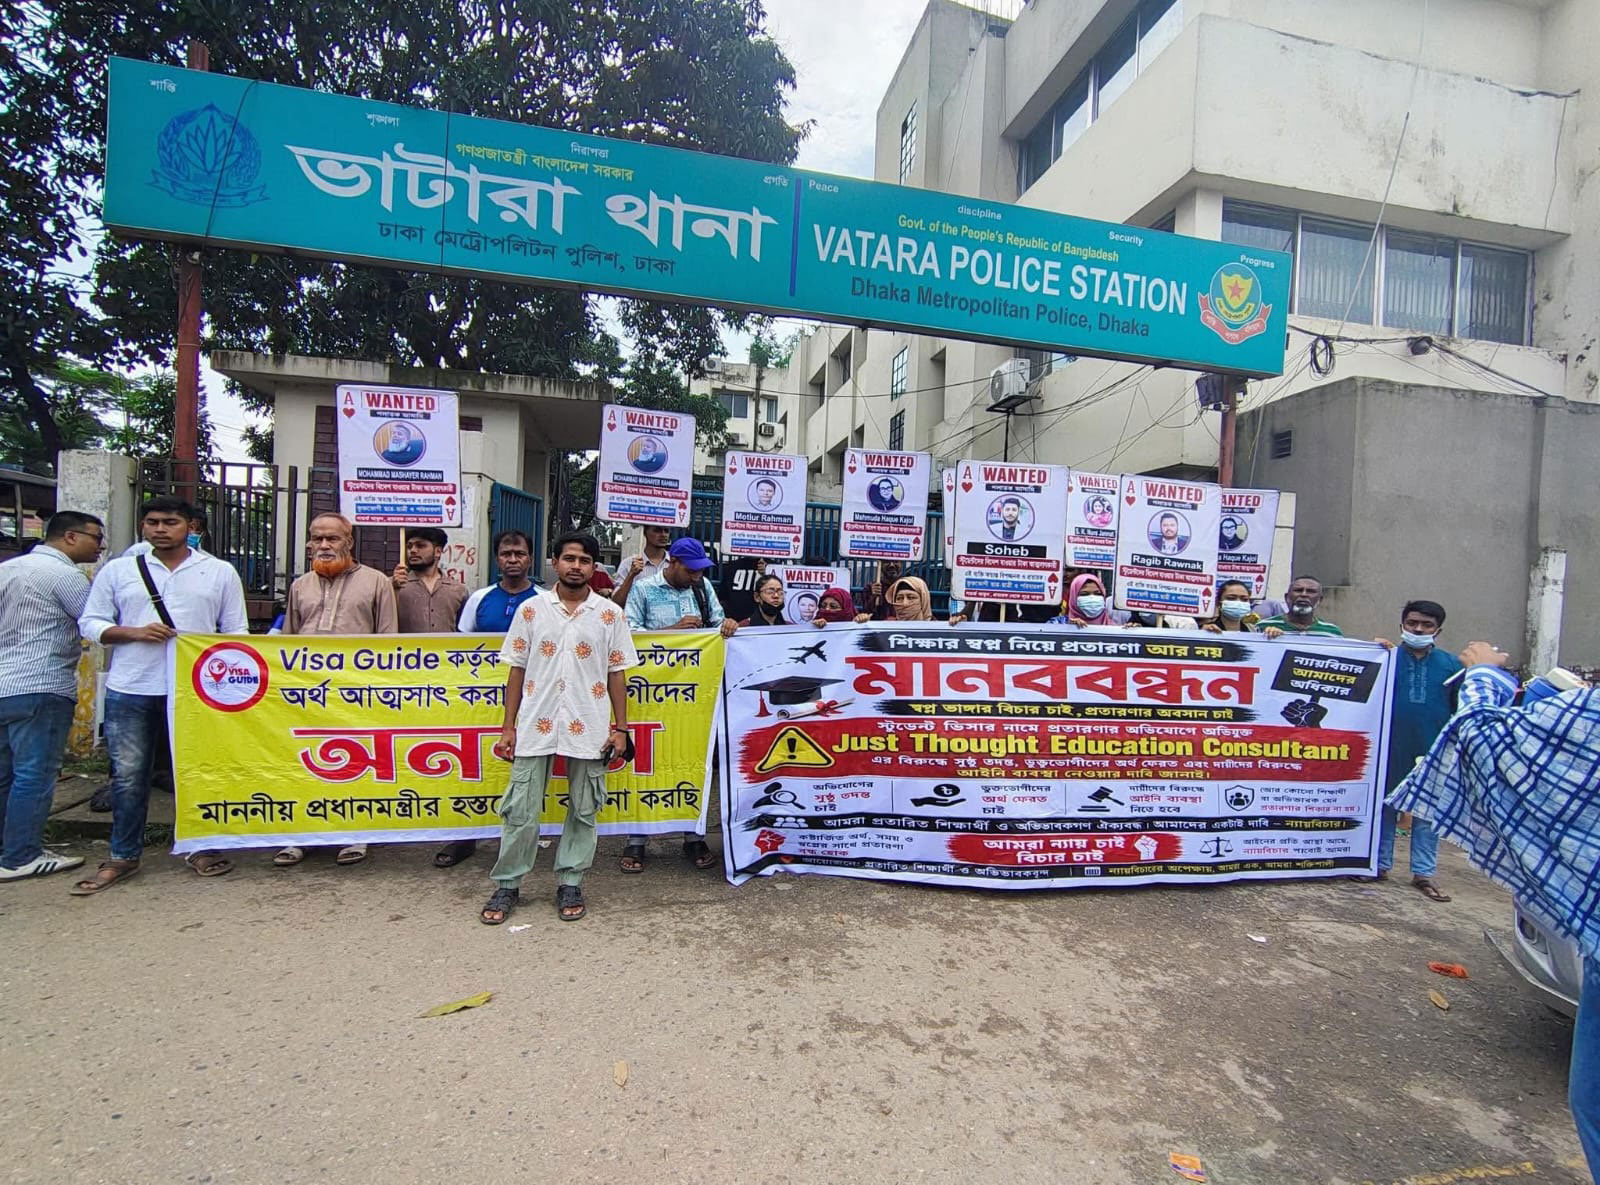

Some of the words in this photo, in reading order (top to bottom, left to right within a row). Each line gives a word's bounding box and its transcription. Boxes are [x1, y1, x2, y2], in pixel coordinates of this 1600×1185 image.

[149, 77, 177, 94] শান্তি
[455, 140, 527, 168] গণপ্রজাতন্ত্রী
[533, 149, 588, 176] বাংলাদেশ
[591, 160, 634, 183] সরকার
[762, 173, 789, 188] প্রগতি
[808, 179, 840, 194] Peace
[284, 141, 583, 236] ভাটারা
[605, 189, 779, 263] থানা
[957, 204, 1003, 221] discipline
[898, 214, 927, 233] Govt.
[928, 221, 941, 234] of
[942, 222, 960, 236] the
[961, 225, 1004, 247] People's
[1005, 231, 1050, 252] Republic
[1051, 239, 1064, 253] of
[1063, 240, 1120, 264] Bangladesh
[1109, 231, 1144, 247] Security
[377, 221, 424, 246] ঢাকা
[433, 223, 557, 263] মেট্রোপলিটন
[564, 244, 626, 274] পুলিশ,
[634, 252, 677, 277] ঢাকা
[1240, 253, 1276, 269] Progress
[813, 223, 942, 280] VATARA
[950, 250, 1061, 298] POLICE
[1070, 265, 1188, 316] STATION
[850, 277, 913, 304] Dhaka
[916, 286, 1031, 326] Metropolitan
[1035, 301, 1093, 332] Police,
[1097, 312, 1149, 338] Dhaka
[366, 393, 435, 411] WANTED
[625, 412, 678, 429] WANTED
[745, 457, 792, 470] WANTED
[865, 454, 914, 468] WANTED
[420, 472, 442, 480] RAHMAN
[983, 467, 1047, 484] WANTED
[1079, 476, 1118, 489] WANTED
[1145, 482, 1203, 501] WANTED
[735, 512, 760, 521] Motiur
[761, 514, 793, 524] Rahman
[984, 544, 1029, 556] Soheb
[1133, 554, 1161, 566] Ragib
[1164, 558, 1202, 570] Rawnak
[786, 569, 834, 583] WANTED
[887, 634, 960, 650] শিক্ষার
[965, 637, 1002, 651] স্বপ্ন
[1008, 637, 1056, 652] নিয়ে
[1062, 641, 1141, 655] প্রতারণা
[1145, 643, 1190, 657] আর
[1194, 645, 1224, 659] নয়
[280, 646, 345, 671] Visa
[353, 647, 440, 671] Guide
[1293, 655, 1365, 675] ন্যায়বিচার
[228, 668, 250, 676] VISA
[228, 676, 259, 684] GUIDE
[1292, 666, 1357, 685] আমাদের
[845, 656, 1259, 705] মানববন্ধন
[1290, 678, 1352, 696] অধিকার
[280, 679, 332, 709] অর্থ
[338, 684, 449, 711] আত্মসাৎ
[908, 703, 938, 715] স্বপ্ন
[996, 702, 1041, 715] বিচার
[1085, 706, 1153, 718] প্রতারণার
[1156, 708, 1209, 720] অবসান
[1212, 708, 1234, 720] চাই
[876, 720, 936, 733] স্টুডেন্ট
[943, 720, 996, 732] ভিসার
[1002, 721, 1039, 733] নামে
[1047, 724, 1121, 735] প্রতারণার
[1125, 725, 1196, 737] অভিযোগে
[1202, 725, 1255, 738] অভিযুক্ত
[832, 733, 899, 754] Just
[909, 732, 1039, 758] Thought
[1050, 734, 1192, 757] Education
[1203, 739, 1350, 761] Consultant
[871, 756, 892, 765] এর
[898, 755, 949, 767] বিরুদ্ধে
[954, 757, 977, 768] সুষ্ঠু
[983, 757, 1018, 767] তদন্ত,
[1114, 756, 1137, 768] অর্থ
[1141, 759, 1178, 768] ফেরত
[1183, 759, 1209, 769] এবং
[1212, 759, 1253, 770] দায়ীদের
[1257, 760, 1303, 771] বিরুদ্ধে
[956, 767, 1006, 778] আইনি
[1011, 768, 1058, 779] ব্যবস্থা
[1064, 769, 1121, 779] নেওয়ার
[1126, 769, 1153, 779] দাবি
[1158, 769, 1210, 779] জানাই।
[812, 780, 874, 791] অভিযোগের
[1128, 783, 1165, 792] দায়ীদের
[1170, 783, 1205, 793] বিরুদ্ধে
[197, 793, 296, 824] মাননীয়
[305, 788, 440, 820] প্রধানমন্ত্রীর
[638, 781, 701, 812] করছি
[814, 792, 835, 803] সুষ্ঠু
[840, 791, 871, 800] তদন্ত
[981, 794, 1008, 803] অর্থ
[1012, 795, 1048, 804] ফেরত
[1129, 793, 1161, 803] আইনি
[1166, 795, 1202, 804] ব্যবস্থা
[813, 803, 837, 813] চাই
[981, 805, 1005, 814] চাই
[1130, 804, 1154, 813] নিতে
[1159, 805, 1181, 813] হবে
[824, 816, 865, 827] আমরা
[871, 816, 930, 829] প্রতারিত
[935, 819, 990, 831] শিক্ষার্থী
[996, 823, 1008, 831] ও
[1015, 820, 1092, 831] অভিভাবকগণ
[1153, 820, 1207, 829] আমাদের
[1211, 818, 1244, 829] একটাই
[1248, 817, 1269, 828] দাবি
[861, 841, 904, 851] প্রতারণা
[876, 834, 900, 843] সময়
[983, 839, 1044, 851] আমরা
[1050, 838, 1088, 849] ন্যায়
[1095, 835, 1125, 848] চাই
[1016, 850, 1066, 864] বিচার
[1072, 849, 1105, 862] চাই
[1325, 845, 1352, 853] আমরা
[864, 860, 908, 871] প্রতারিত
[913, 862, 955, 874] শিক্ষার্থী
[1108, 864, 1163, 874] ন্যায়বিচারের
